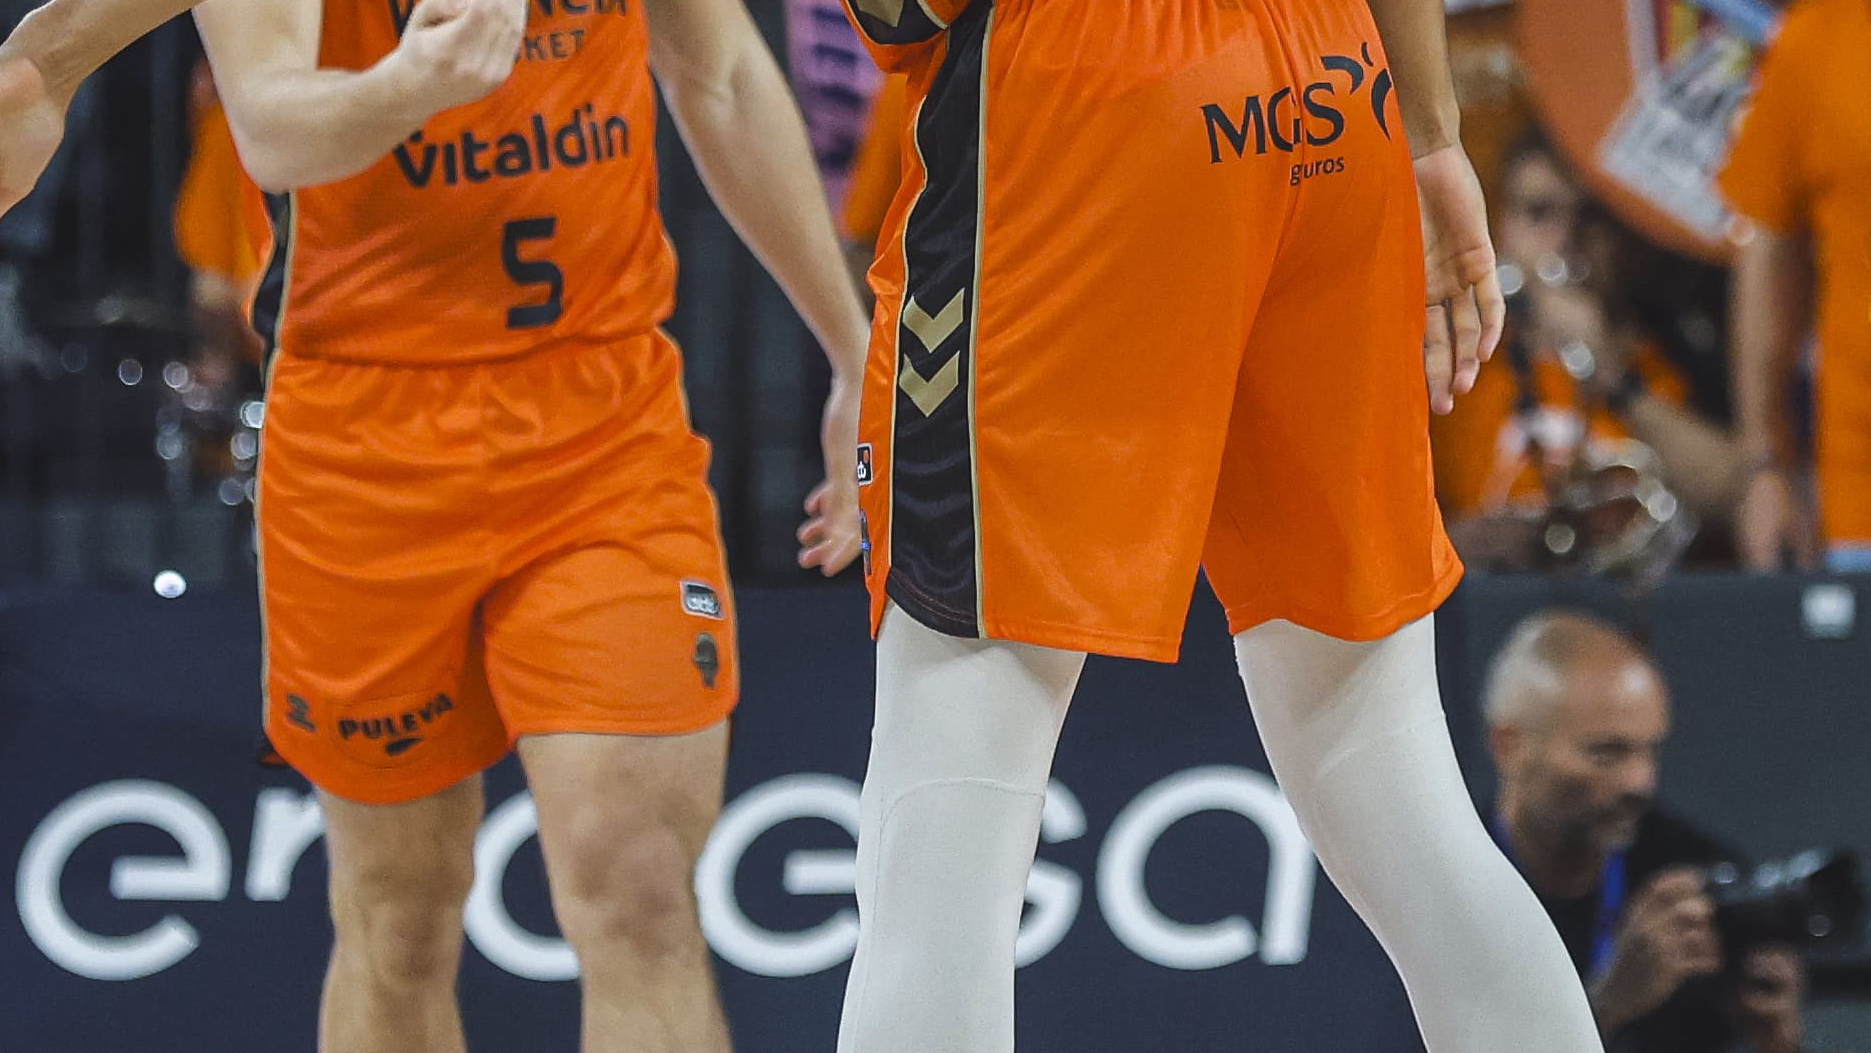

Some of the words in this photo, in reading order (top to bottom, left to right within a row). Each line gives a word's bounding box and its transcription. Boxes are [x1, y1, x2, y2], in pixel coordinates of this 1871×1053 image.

[1200, 81, 1345, 165] MGS
[500, 217, 564, 330] 5
[338, 692, 455, 741] PULEVA
